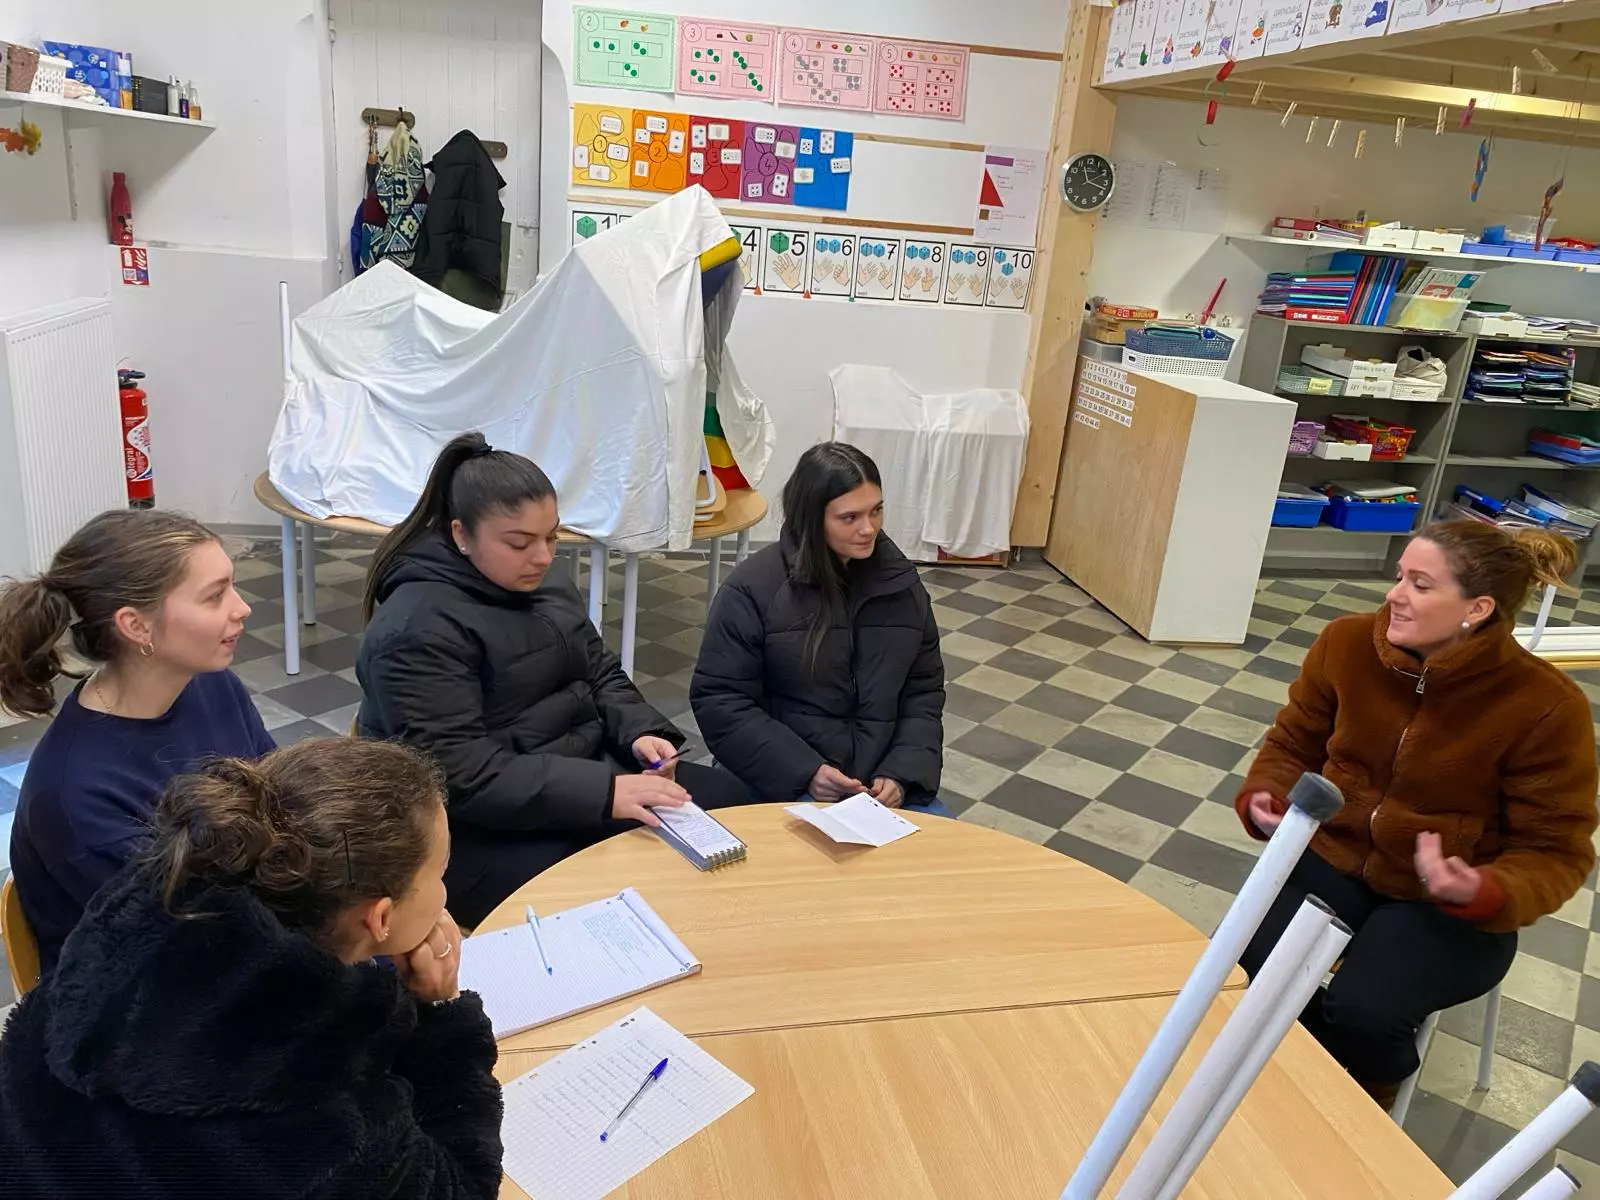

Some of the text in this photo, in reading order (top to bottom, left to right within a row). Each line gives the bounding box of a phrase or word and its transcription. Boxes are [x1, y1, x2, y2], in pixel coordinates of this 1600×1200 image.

[586, 16, 593, 27] 2
[689, 27, 697, 38] 3
[791, 39, 798, 48] 4
[886, 48, 893, 59] 5
[654, 147, 661, 157] 2
[764, 158, 772, 169] 4
[601, 215, 611, 229] 1
[742, 229, 757, 251] 4
[791, 234, 806, 256] 5
[841, 239, 853, 256] 6
[886, 243, 897, 260] 7
[931, 246, 942, 263] 8
[977, 250, 987, 267] 9
[1012, 252, 1032, 269] 10
